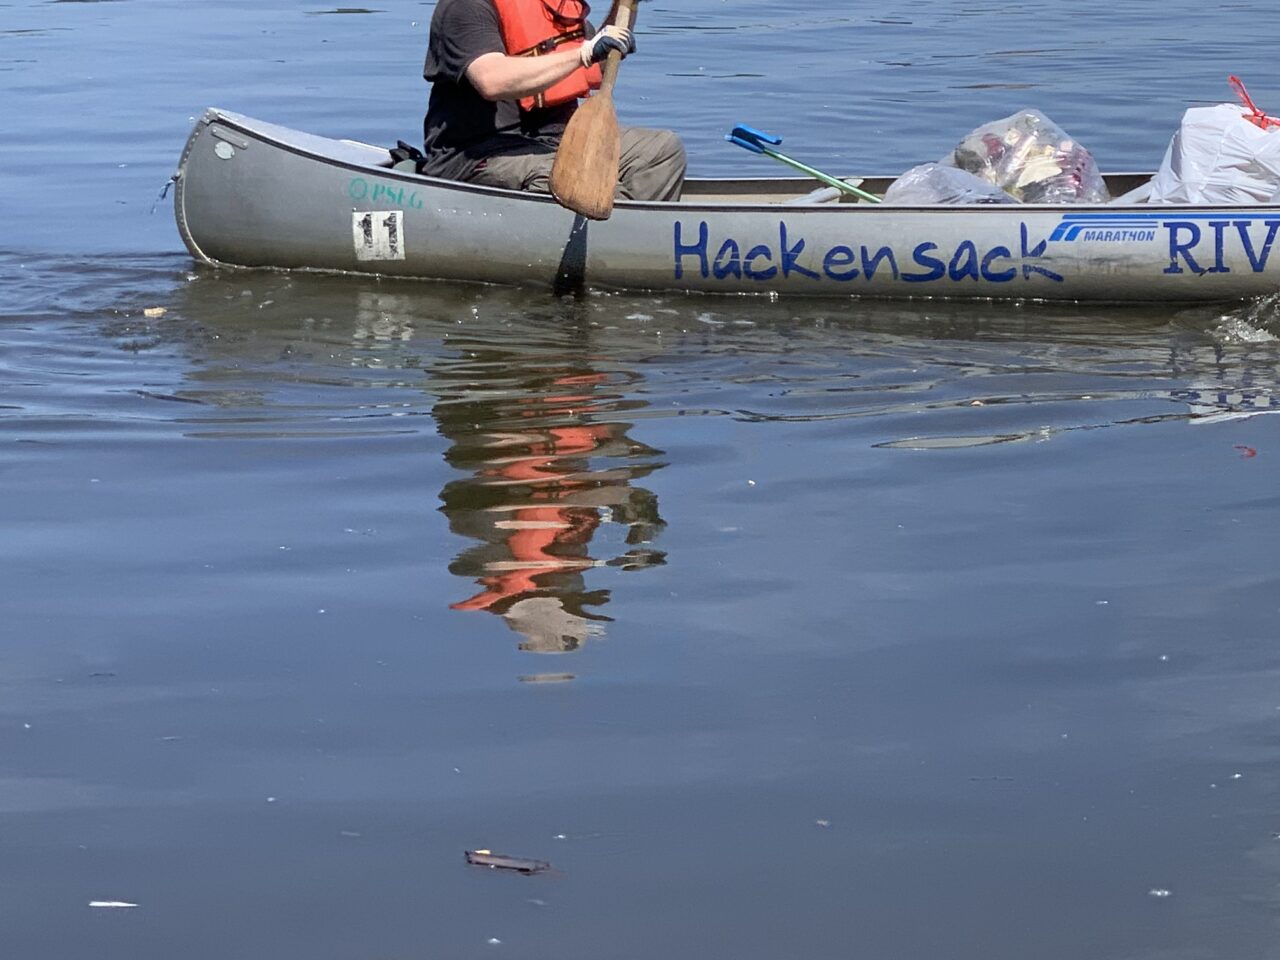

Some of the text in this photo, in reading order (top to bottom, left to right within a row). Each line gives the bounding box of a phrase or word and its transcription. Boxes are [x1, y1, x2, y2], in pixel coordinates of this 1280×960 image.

[358, 213, 398, 256] 11
[673, 220, 1065, 283] Hackensack
[1083, 230, 1156, 242] MARATHON
